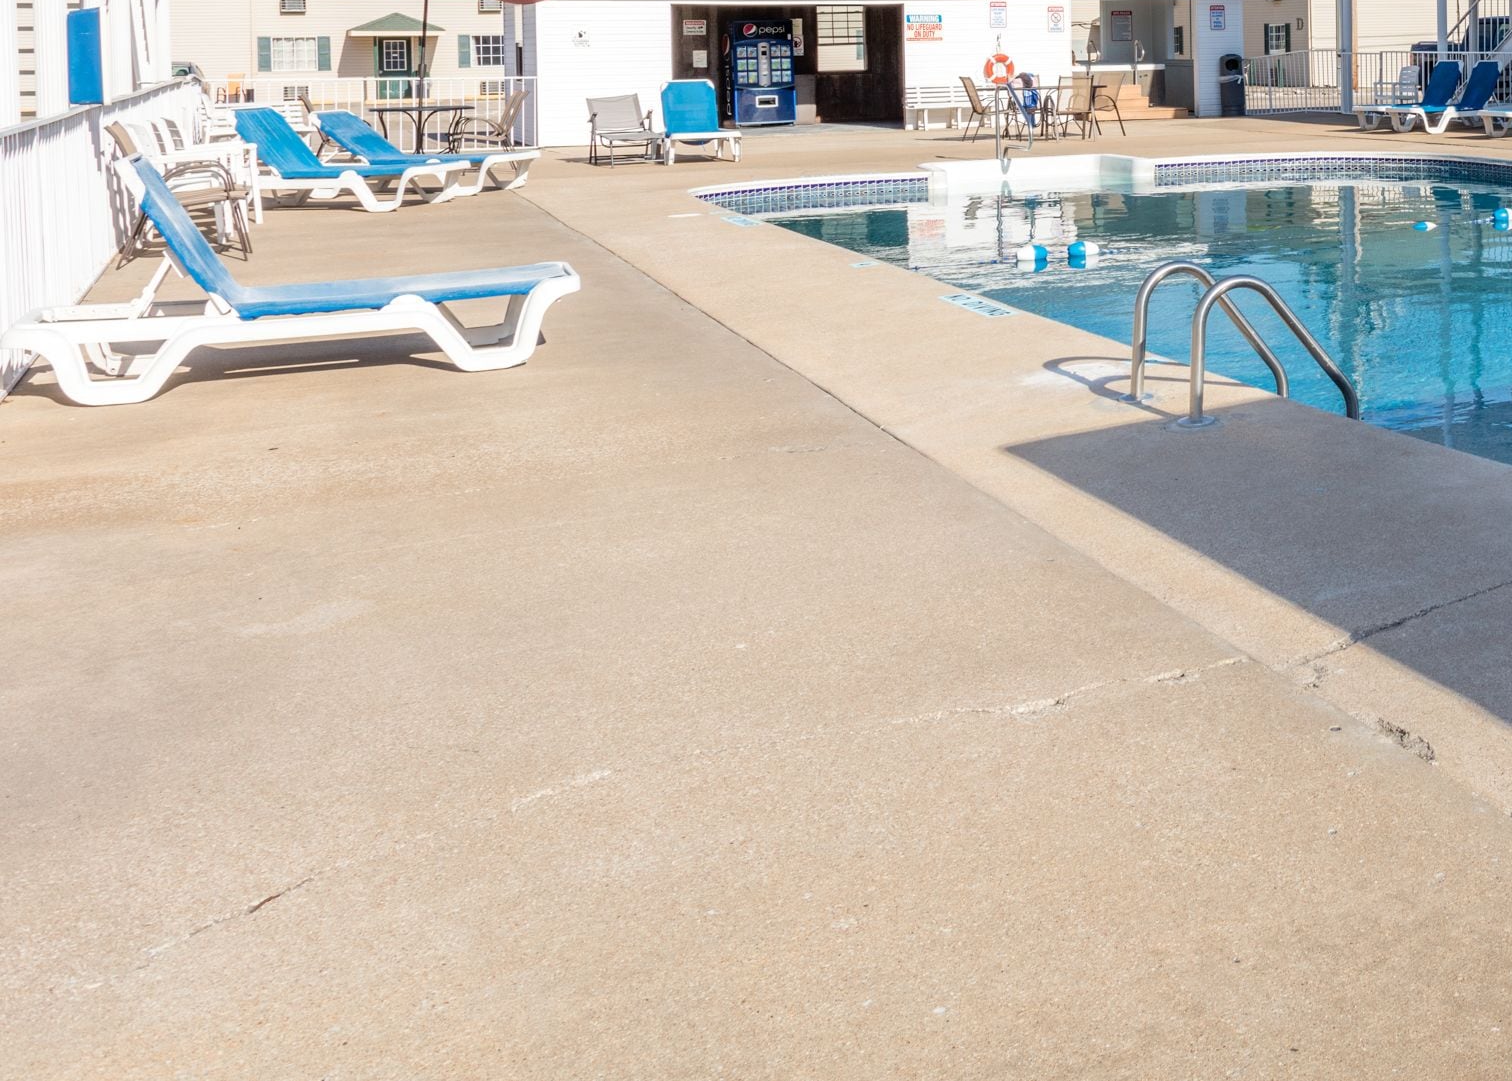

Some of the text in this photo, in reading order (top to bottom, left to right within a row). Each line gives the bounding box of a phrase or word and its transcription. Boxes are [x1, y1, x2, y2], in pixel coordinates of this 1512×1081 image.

[909, 15, 940, 23] WARNING
[1296, 18, 1304, 31] D
[758, 25, 785, 35] pepsi
